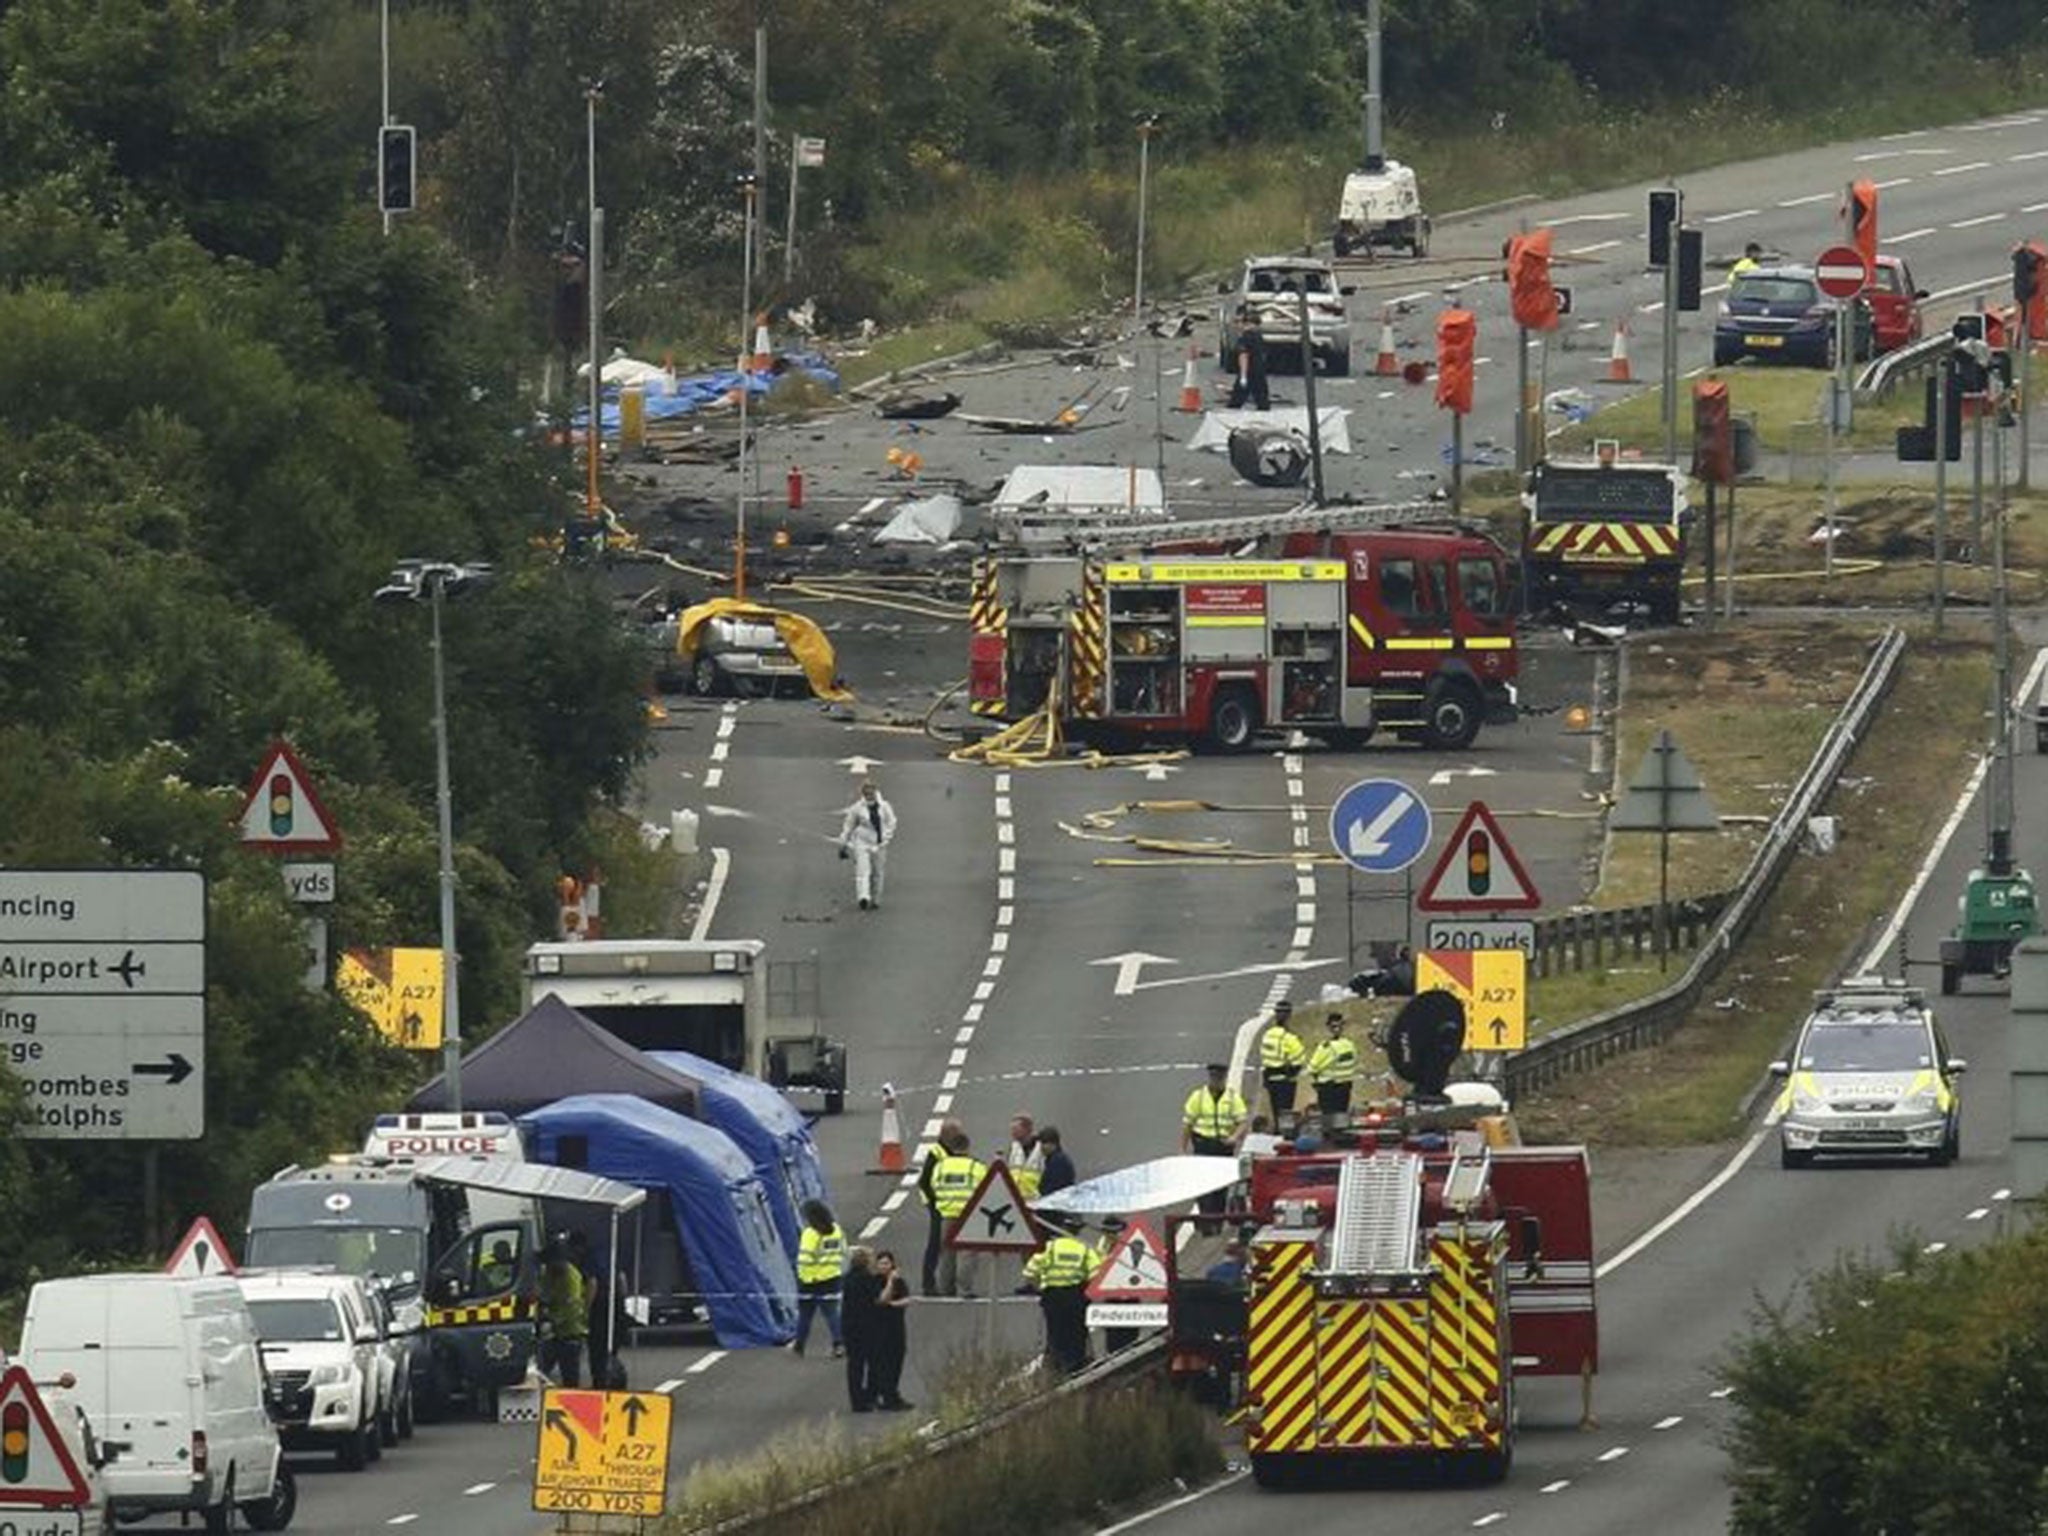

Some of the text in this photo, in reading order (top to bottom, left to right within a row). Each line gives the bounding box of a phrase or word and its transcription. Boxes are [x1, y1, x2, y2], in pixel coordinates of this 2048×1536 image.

[290, 872, 330, 897] yds
[1434, 931, 1484, 949] 200
[0, 955, 99, 984] Airport
[401, 985, 437, 1000] A27
[1481, 987, 1517, 1002] A27
[388, 1137, 497, 1157] POLICE
[616, 1442, 657, 1461] A27
[550, 1492, 645, 1511] 200 YDS
